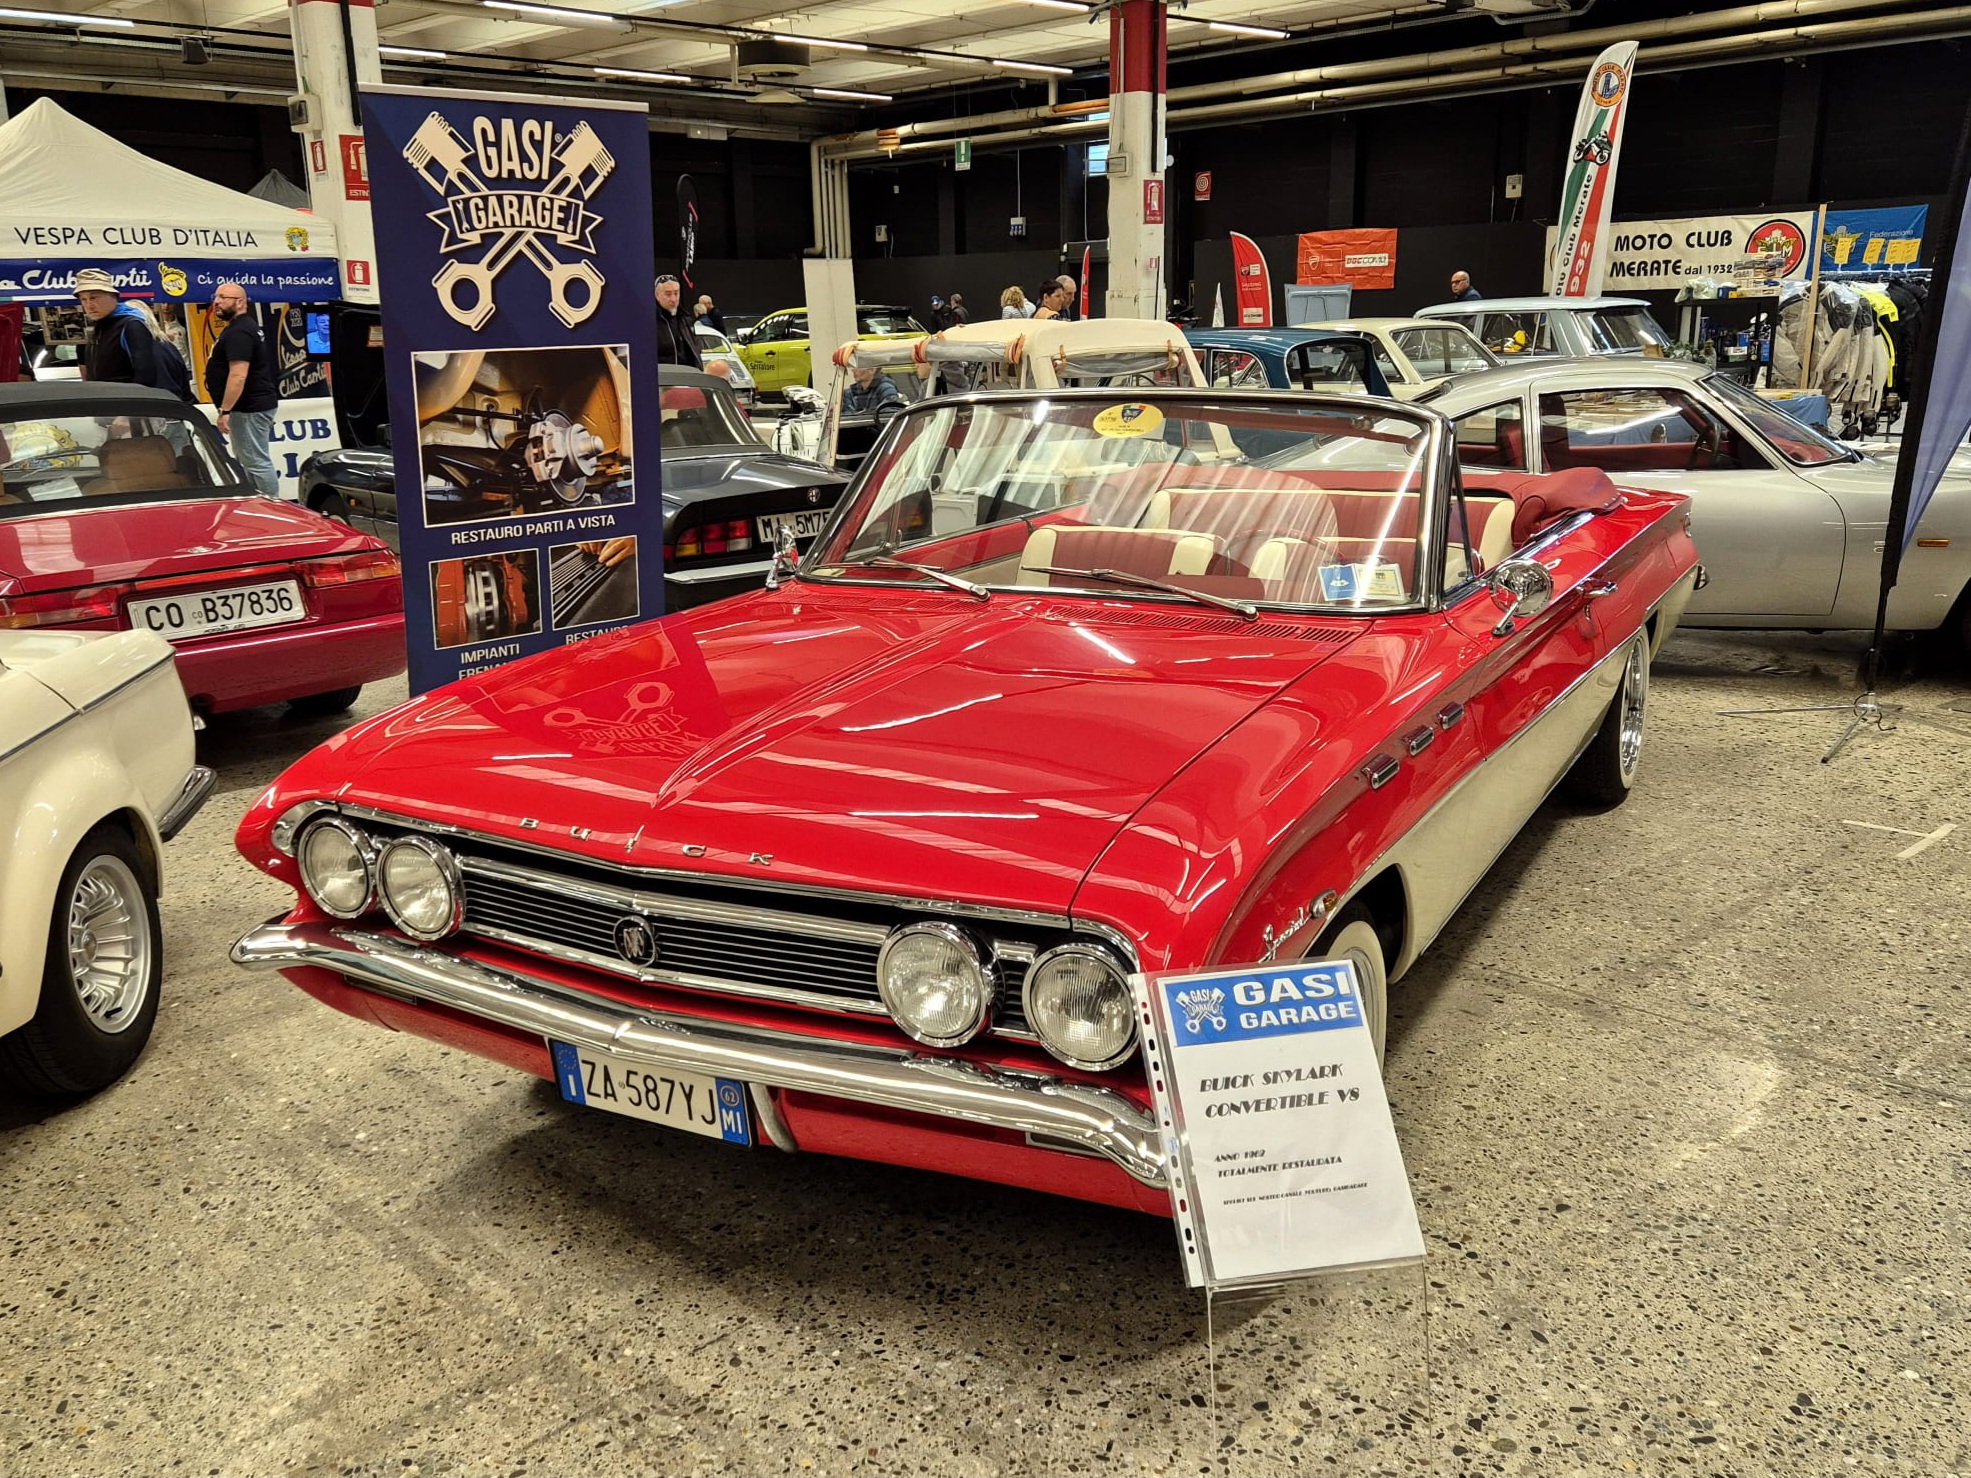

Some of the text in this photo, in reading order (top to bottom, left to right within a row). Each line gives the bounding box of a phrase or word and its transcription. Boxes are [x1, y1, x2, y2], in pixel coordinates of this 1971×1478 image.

[472, 115, 553, 180] GASI
[349, 189, 370, 197] ESTIN
[468, 194, 567, 232] GARAGE
[1563, 233, 1576, 267] Club
[1573, 174, 1593, 228] Merate
[13, 226, 259, 248] VESPA CLUB D'ITALIA
[1613, 229, 1733, 252] MOTO CLUB
[22, 268, 77, 290] Club
[1609, 259, 1733, 277] MERATE dal 1932
[261, 273, 275, 285] la
[277, 272, 334, 289] passione
[279, 375, 300, 398] Club
[268, 418, 332, 442] LUB
[451, 514, 616, 545] RESTAURO PARTI A VISTA
[145, 587, 293, 631] CO B37836
[461, 643, 520, 664] IMPIANTI
[1233, 971, 1350, 1006] GASI
[1239, 1001, 1357, 1029] GARAGE
[568, 1074, 577, 1097] I
[1200, 1063, 1343, 1092] BUICK SKYLARK
[581, 1060, 716, 1125] ZA 587YJ
[1205, 1087, 1360, 1119] CONVERTIBLE V8
[721, 1108, 743, 1134] MI
[1214, 1149, 1266, 1163] ANNO 1962
[1218, 1155, 1342, 1178] TOTALMENTE RESTAURATA
